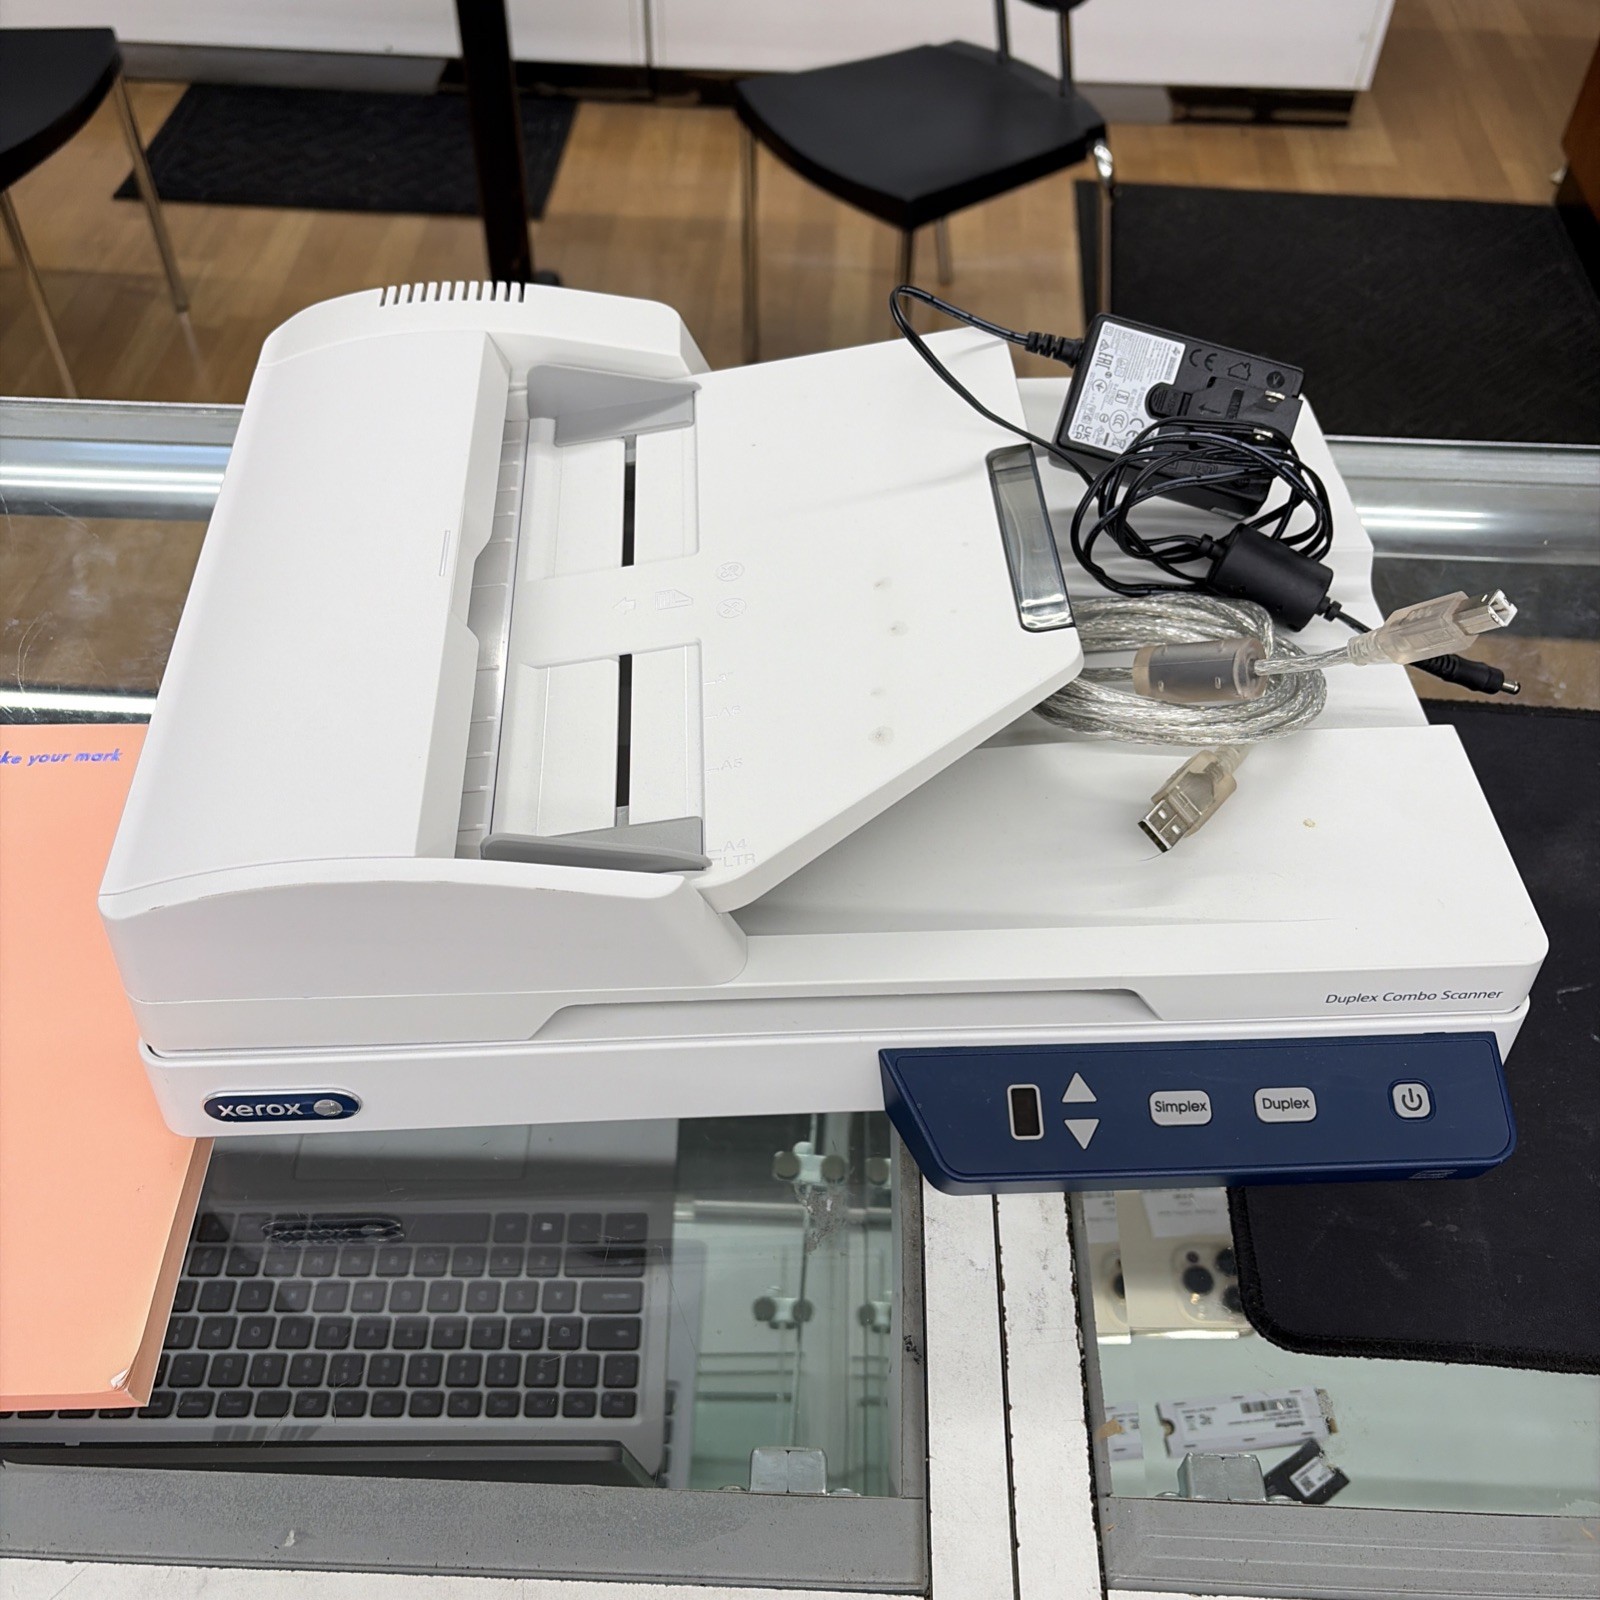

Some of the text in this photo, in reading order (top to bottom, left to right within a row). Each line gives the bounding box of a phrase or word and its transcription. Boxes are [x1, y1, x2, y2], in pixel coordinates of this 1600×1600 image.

[27, 753, 71, 767] your
[74, 748, 122, 763] mark
[723, 839, 748, 852] A4
[724, 853, 756, 868] LTR
[1325, 989, 1503, 1005] Duplex Combo Scanner
[217, 1102, 303, 1117] xerox
[1154, 1098, 1207, 1116] Simplex
[1262, 1096, 1310, 1113] Duplex
